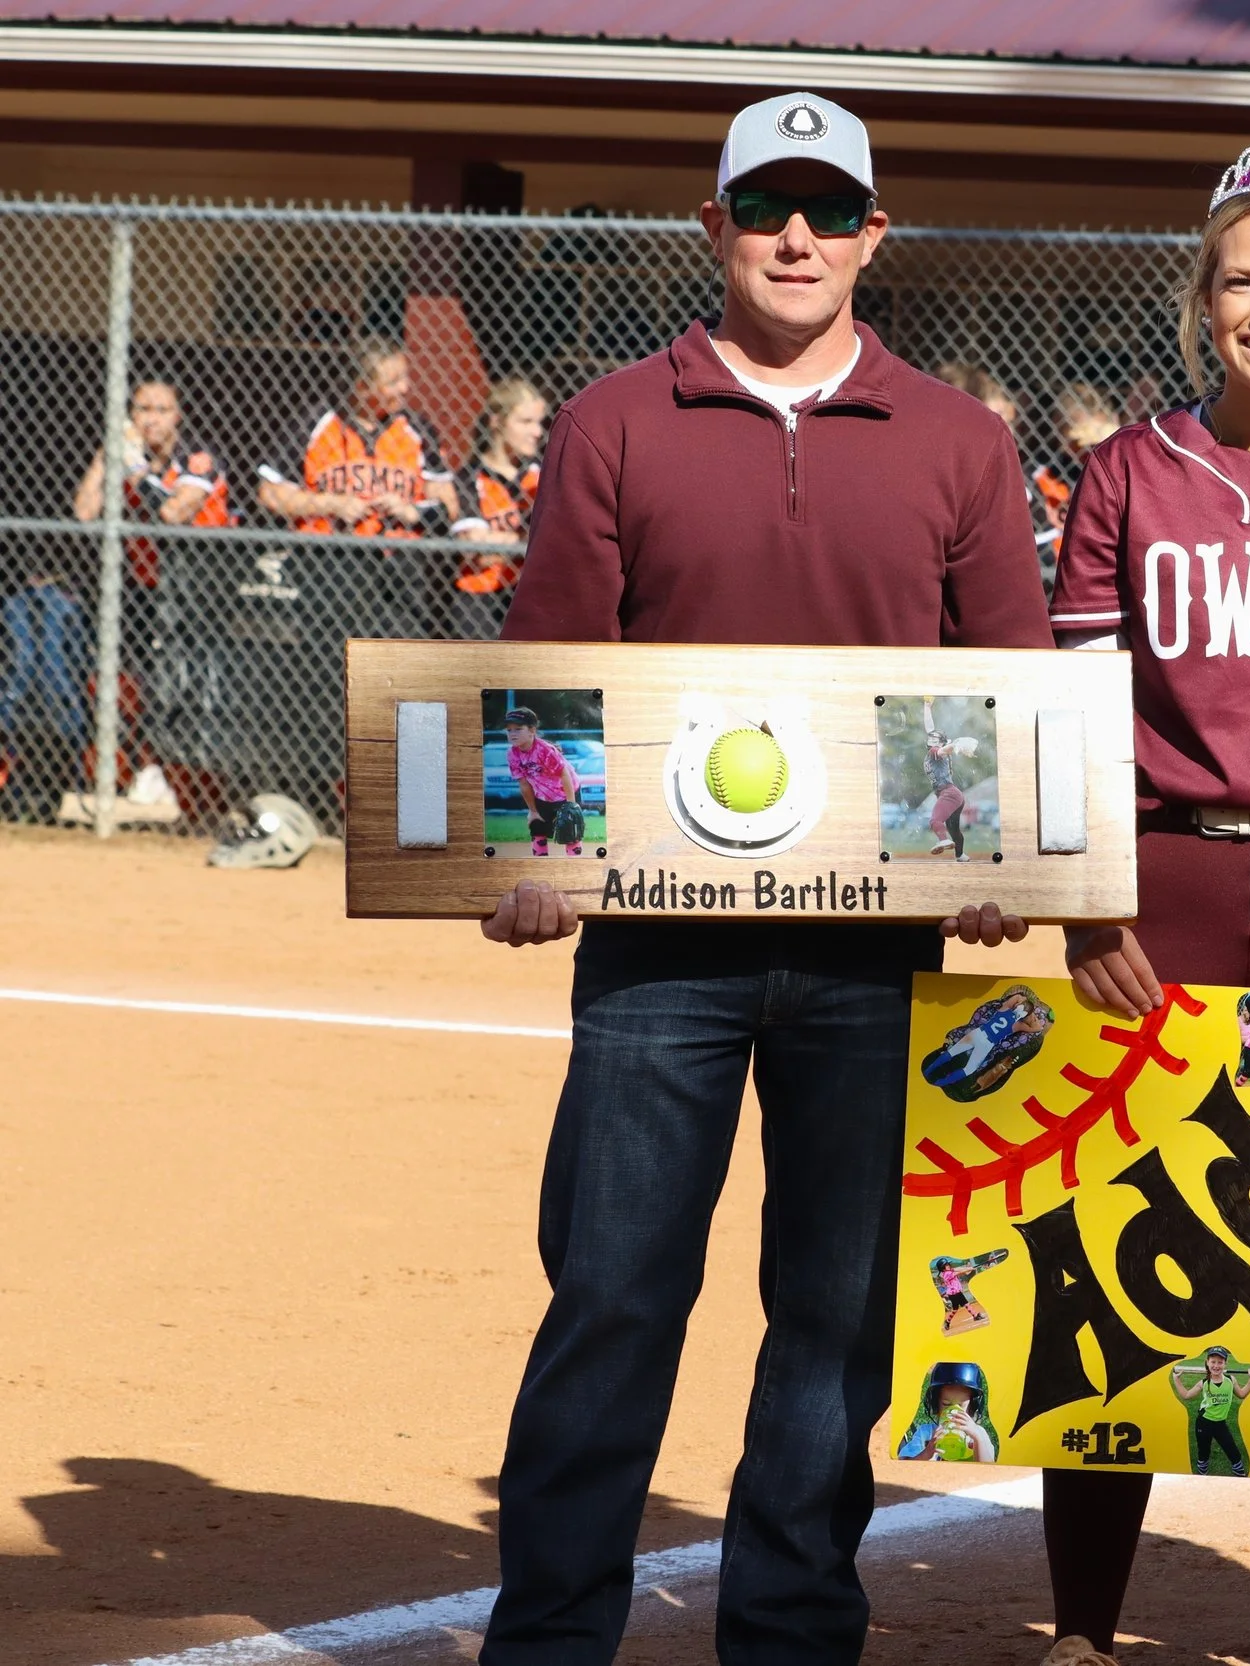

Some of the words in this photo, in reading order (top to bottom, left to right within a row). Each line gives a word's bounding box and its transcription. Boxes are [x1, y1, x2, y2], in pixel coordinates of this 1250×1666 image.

[602, 868, 735, 910] Addison
[754, 870, 888, 911] Bartlett
[990, 1017, 1008, 1034] 2
[1061, 1422, 1146, 1464] #12
